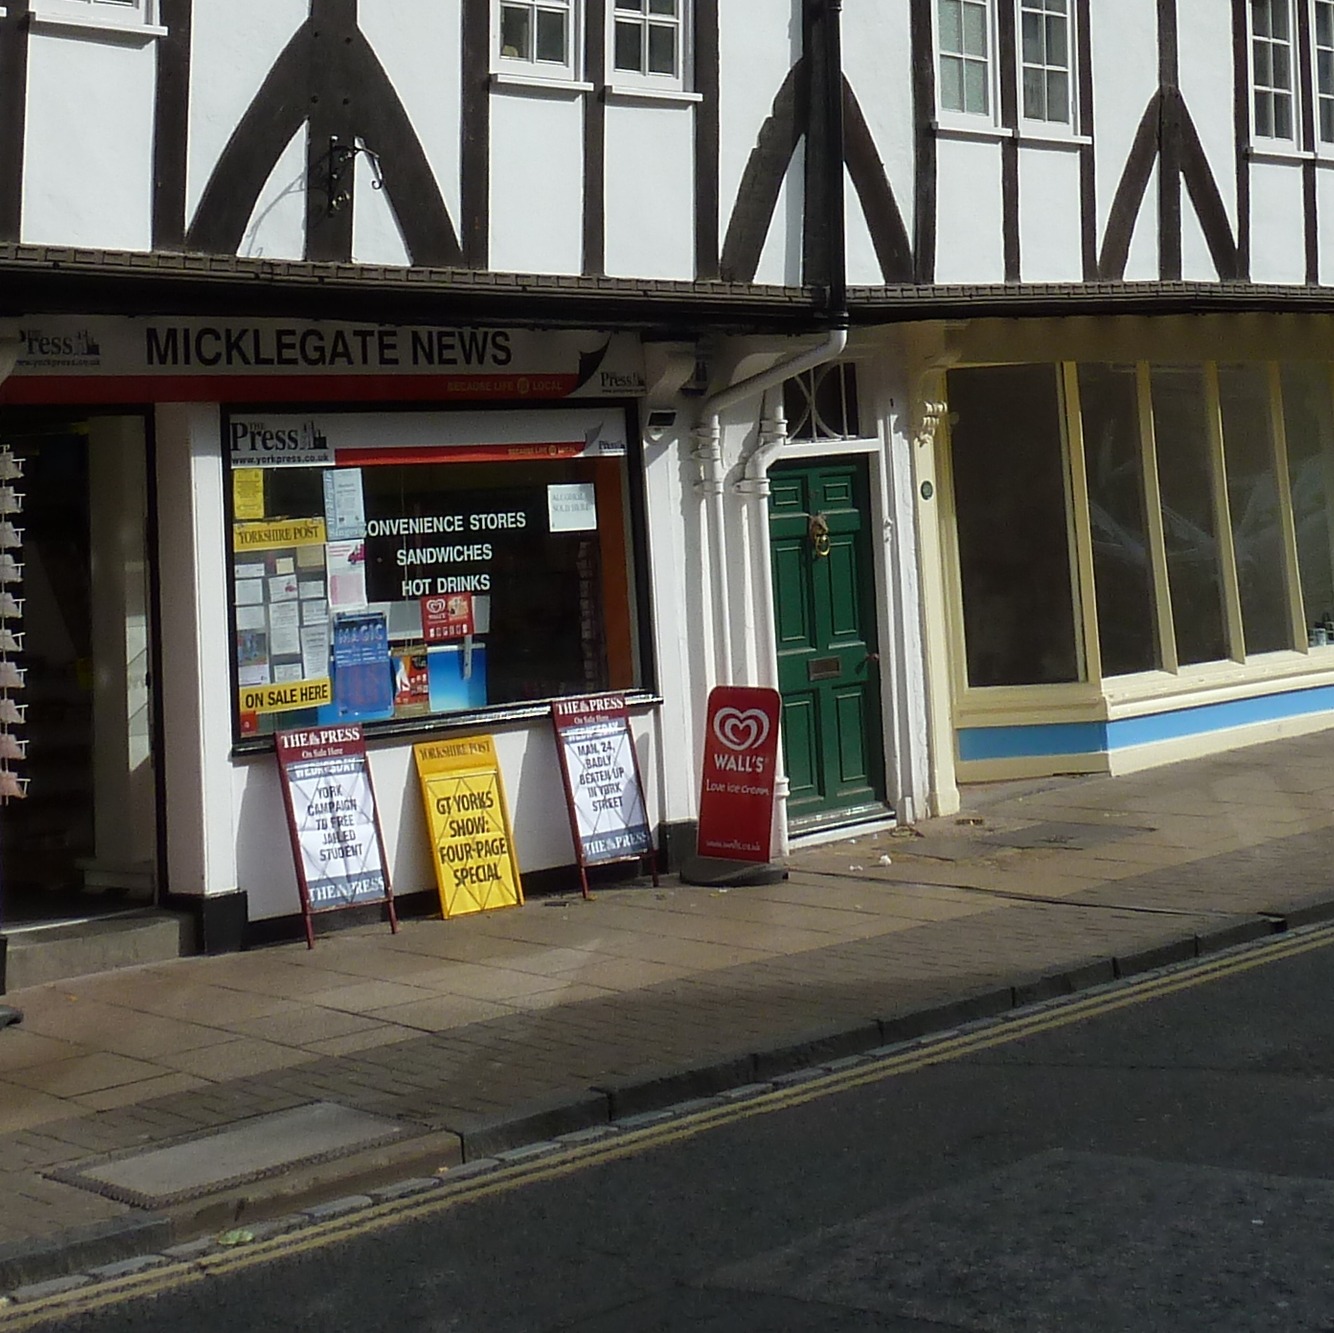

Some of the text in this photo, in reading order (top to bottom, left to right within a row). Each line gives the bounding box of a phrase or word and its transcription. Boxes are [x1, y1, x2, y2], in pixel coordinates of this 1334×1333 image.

[146, 327, 512, 366] MICKLEGATE NEWS
[532, 381, 563, 391] LOCAL
[601, 372, 630, 387] Press
[231, 423, 299, 452] Press
[231, 454, 329, 465] www.yorkpress.co.uk
[367, 515, 464, 537] ONVENIENCE
[470, 512, 527, 530] STORES
[239, 528, 292, 545] YORKSHIRE
[293, 526, 319, 539] POST
[396, 544, 493, 566] SANDWICHES
[402, 574, 491, 597] HOT DRINKS
[246, 684, 329, 709] ON SALE HERE
[556, 697, 624, 715] THE PRESS
[280, 728, 361, 749] THE PRESS
[313, 748, 327, 757] Sale
[419, 740, 490, 761] YORKSHIRE POST
[585, 755, 612, 770] BADLY
[713, 753, 764, 773] WALL'S
[579, 767, 625, 785] BEATEN UP
[318, 784, 342, 799] YORK
[587, 783, 622, 798] IN YORK
[706, 779, 725, 793] Love
[727, 782, 740, 794] ice
[307, 799, 357, 817] CAMPAIGN
[436, 791, 494, 815] GT YORKS
[592, 796, 624, 812] STREET
[315, 814, 355, 831] TO FREE
[449, 816, 491, 839] SHOW:
[322, 830, 356, 846] JAILED
[584, 831, 649, 856] THE PRESS
[319, 844, 363, 862] STUDENT
[439, 837, 507, 865] FOUR-PAGE
[453, 862, 502, 888] SPECIAL
[309, 875, 385, 902] THE PRESS
